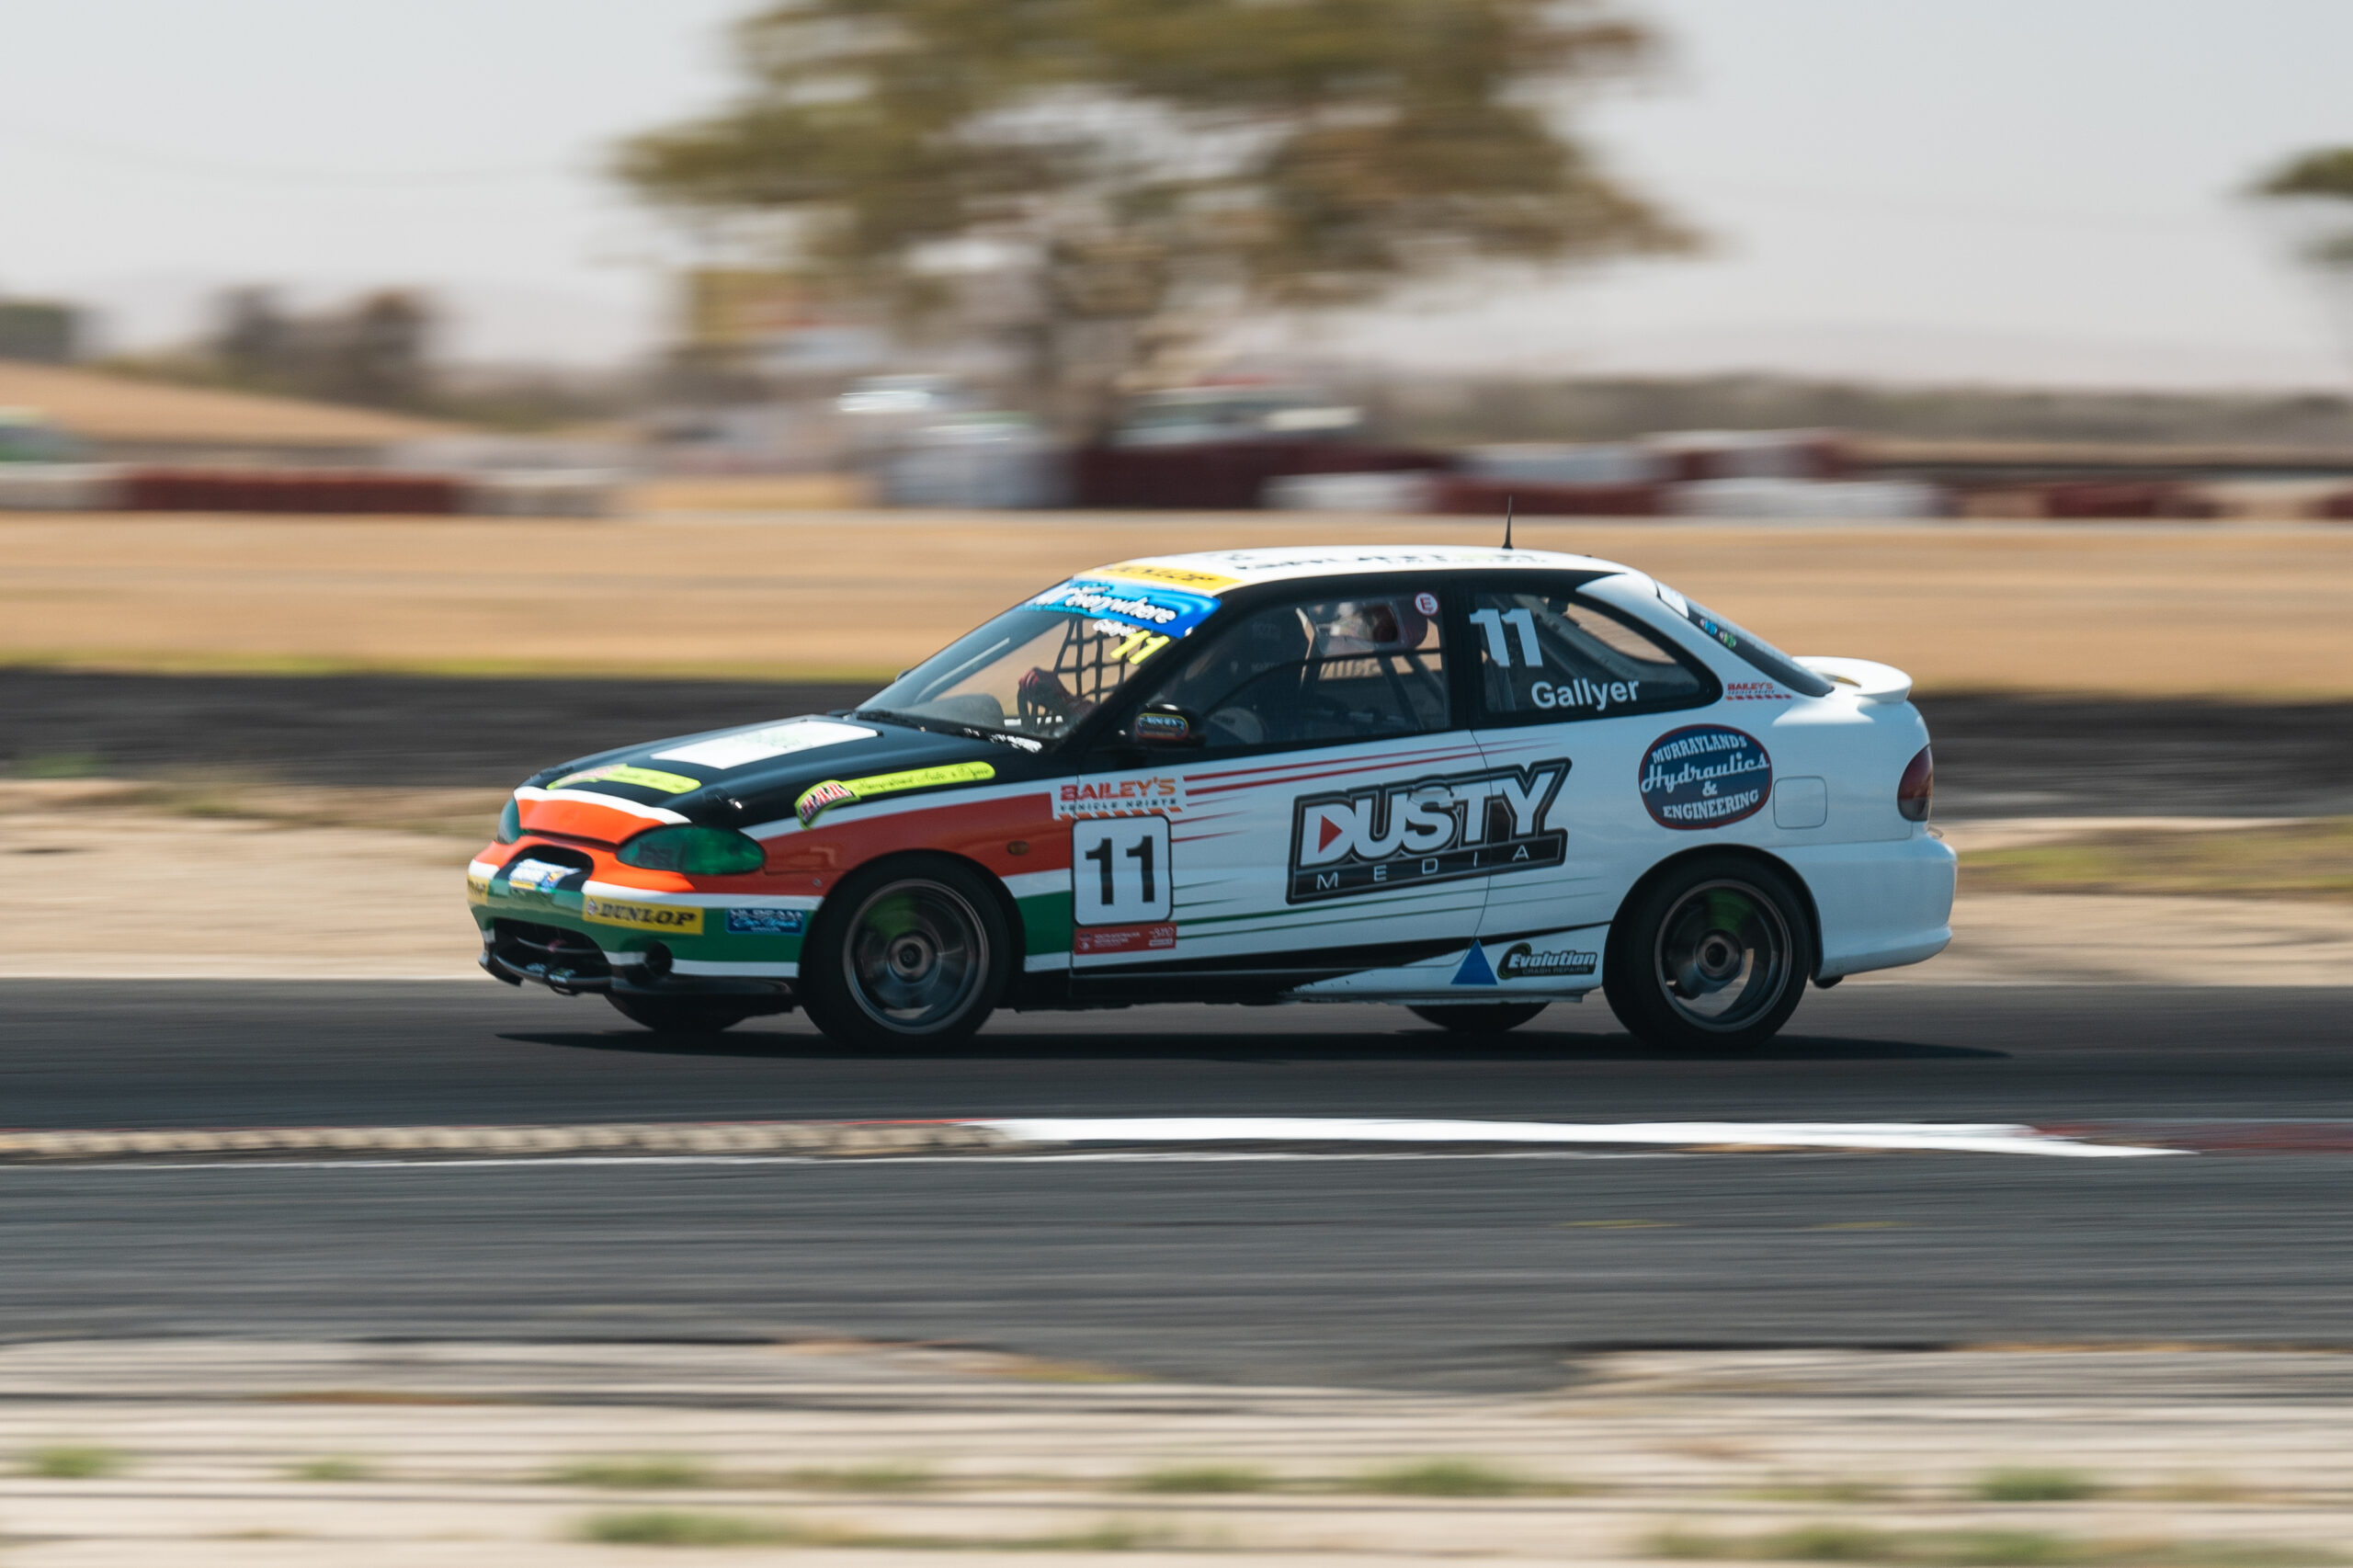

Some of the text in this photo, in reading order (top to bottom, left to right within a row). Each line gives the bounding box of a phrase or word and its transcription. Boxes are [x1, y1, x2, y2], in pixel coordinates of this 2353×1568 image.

[1420, 597, 1434, 610] E
[1110, 630, 1170, 665] 11
[1469, 608, 1544, 668] 11
[1531, 677, 1639, 710] Gallyer
[1652, 733, 1748, 764] MURRAYLANDS
[1641, 752, 1770, 794] Hydraulics
[1701, 780, 1718, 797] &
[1060, 778, 1176, 801] BAILEY'S
[1663, 789, 1759, 820] ENGINEERING
[1298, 769, 1557, 867] DUSTY
[1085, 835, 1155, 905] 11
[1316, 844, 1529, 891] MEDIA
[598, 903, 696, 927] DUNLOP
[1507, 951, 1597, 969] Evolution
